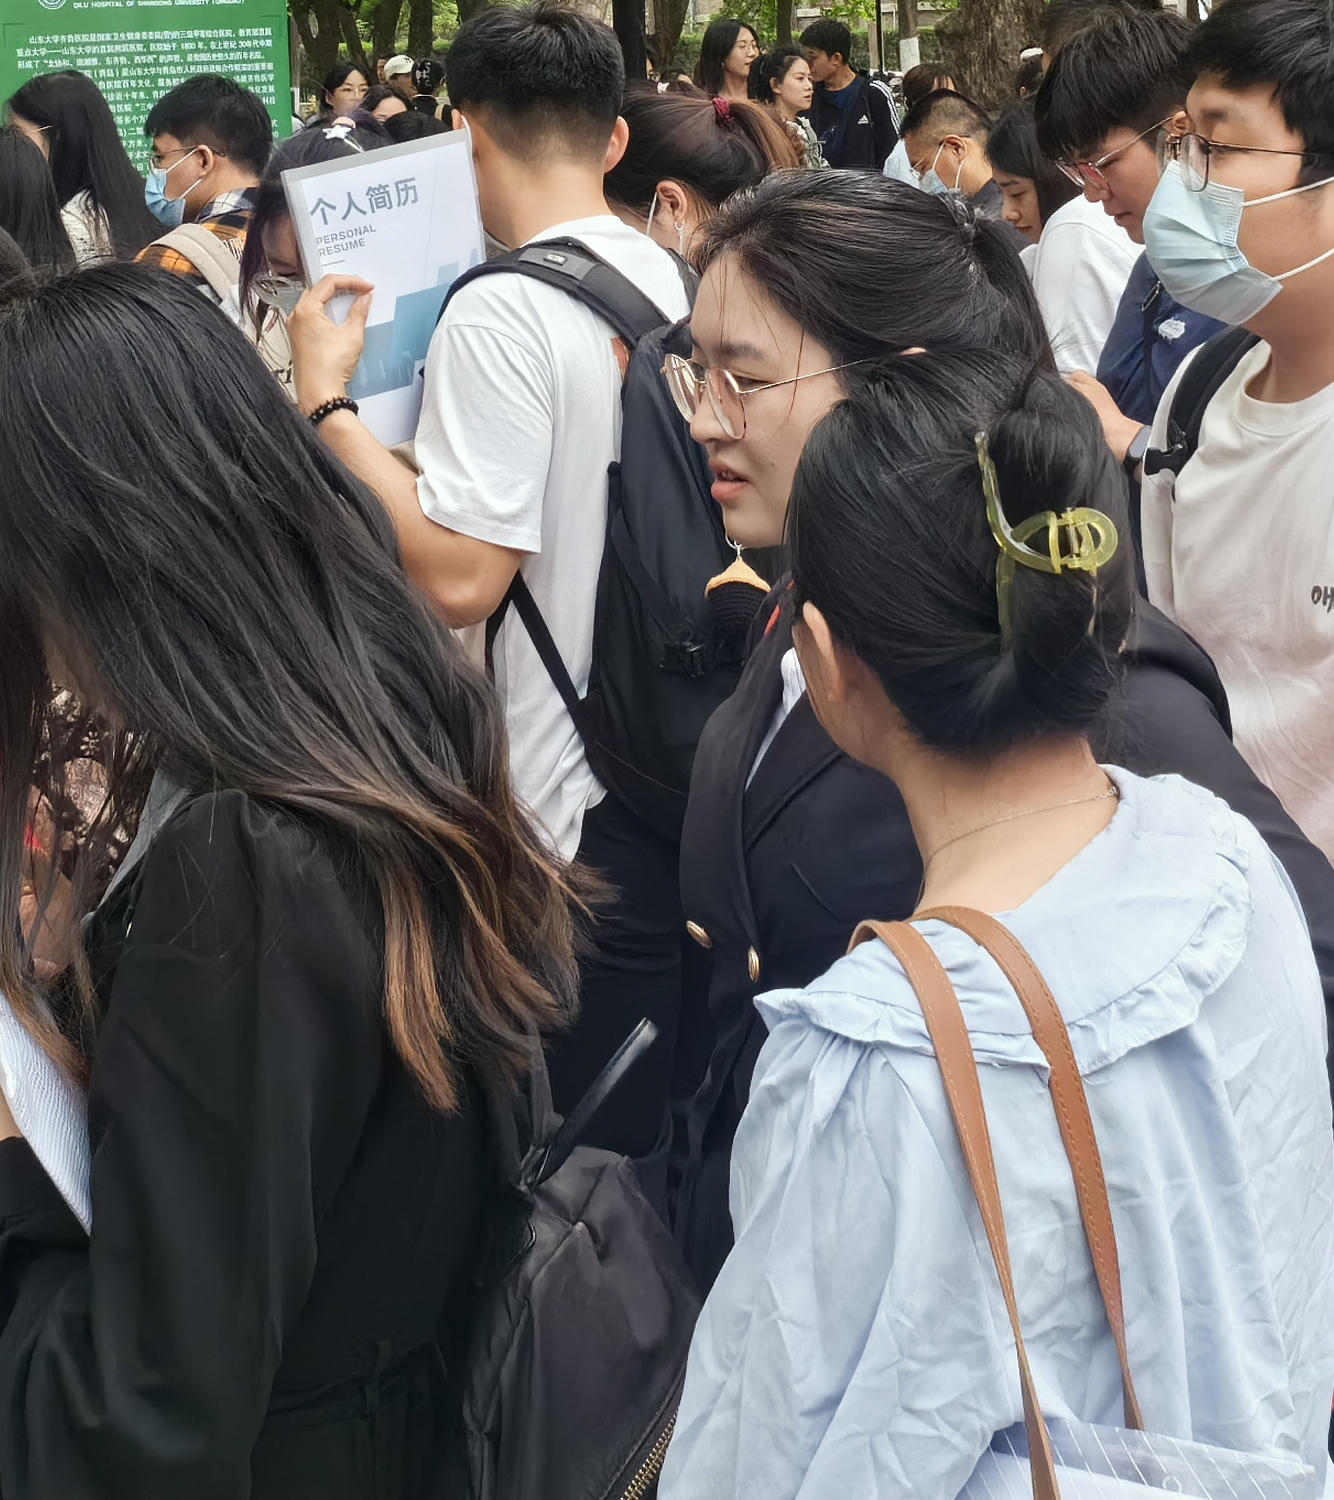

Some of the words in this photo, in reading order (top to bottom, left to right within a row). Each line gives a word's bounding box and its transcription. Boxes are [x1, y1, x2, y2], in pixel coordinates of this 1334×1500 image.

[91, 0, 123, 9] HOSPITAL
[126, 0, 135, 8] OF
[309, 177, 420, 226] 个人简历
[315, 224, 377, 247] PERSONAL
[318, 237, 366, 257] RESUME
